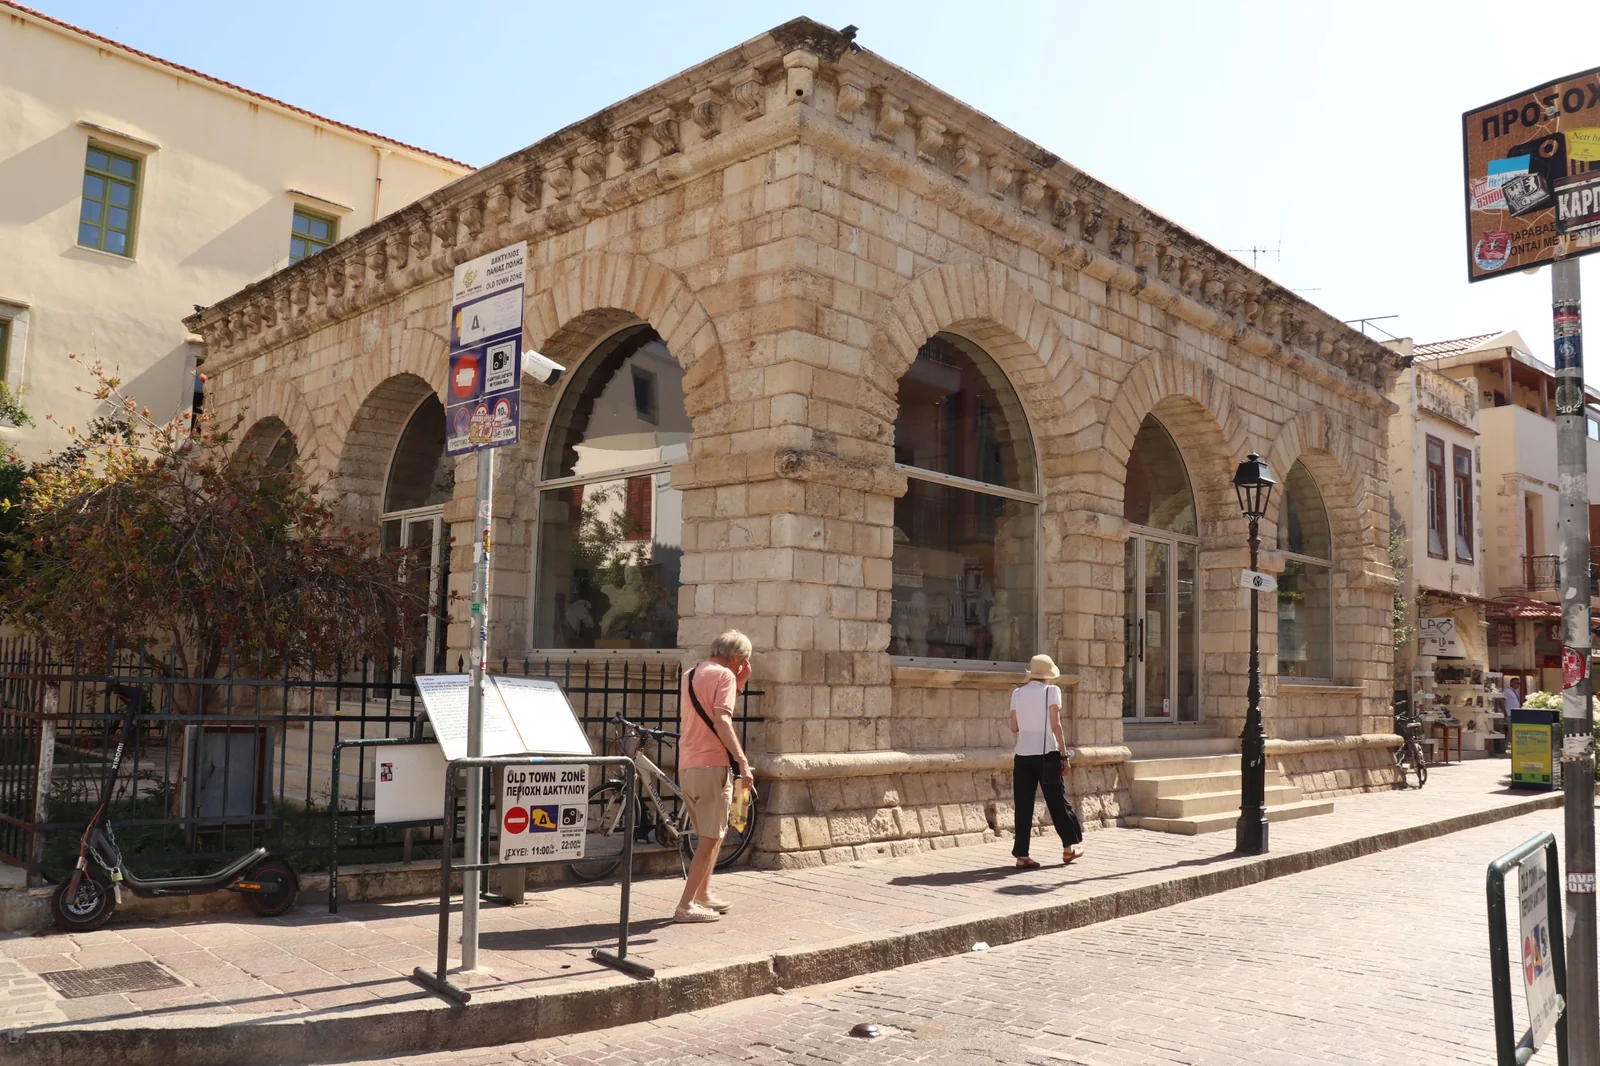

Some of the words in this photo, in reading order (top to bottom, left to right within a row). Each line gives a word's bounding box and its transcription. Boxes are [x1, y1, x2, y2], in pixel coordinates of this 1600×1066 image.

[1544, 235, 1560, 247] ΜΕ
[491, 249, 519, 265] ΔΑΚΤΥΛΙΟΣ
[486, 281, 496, 290] OLD
[496, 276, 509, 287] TOWN
[510, 272, 522, 282] ZONE
[1561, 405, 1573, 414] 10
[507, 772, 526, 784] OLD
[529, 771, 556, 783] TOWN
[561, 771, 585, 782] ZONE
[507, 785, 541, 796] ΠΕΡΙΟΧΗ
[543, 785, 586, 796] ΔΑΚΤΥΛΙΟΥ
[539, 814, 548, 824] Δ
[532, 846, 550, 855] 11:00
